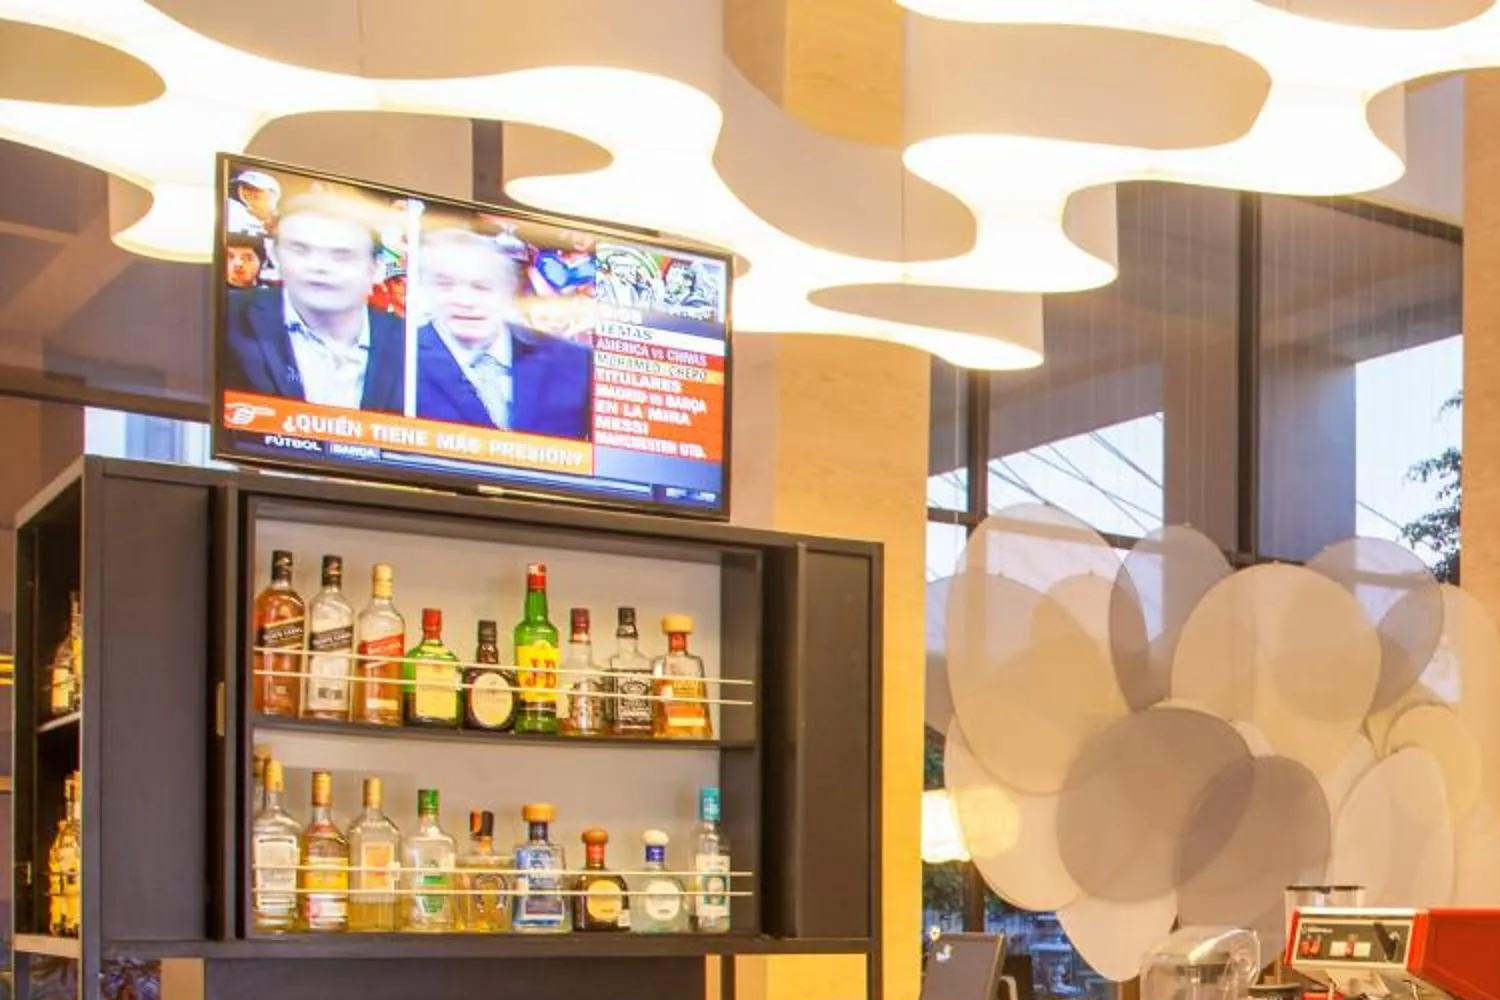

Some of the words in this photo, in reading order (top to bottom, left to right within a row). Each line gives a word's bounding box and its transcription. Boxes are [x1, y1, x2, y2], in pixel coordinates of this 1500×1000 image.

[596, 399, 619, 415] EN
[623, 402, 643, 418] LA
[282, 413, 363, 439] ¿QUIÉN
[370, 422, 429, 448] TIENE
[596, 415, 649, 435] MESSI
